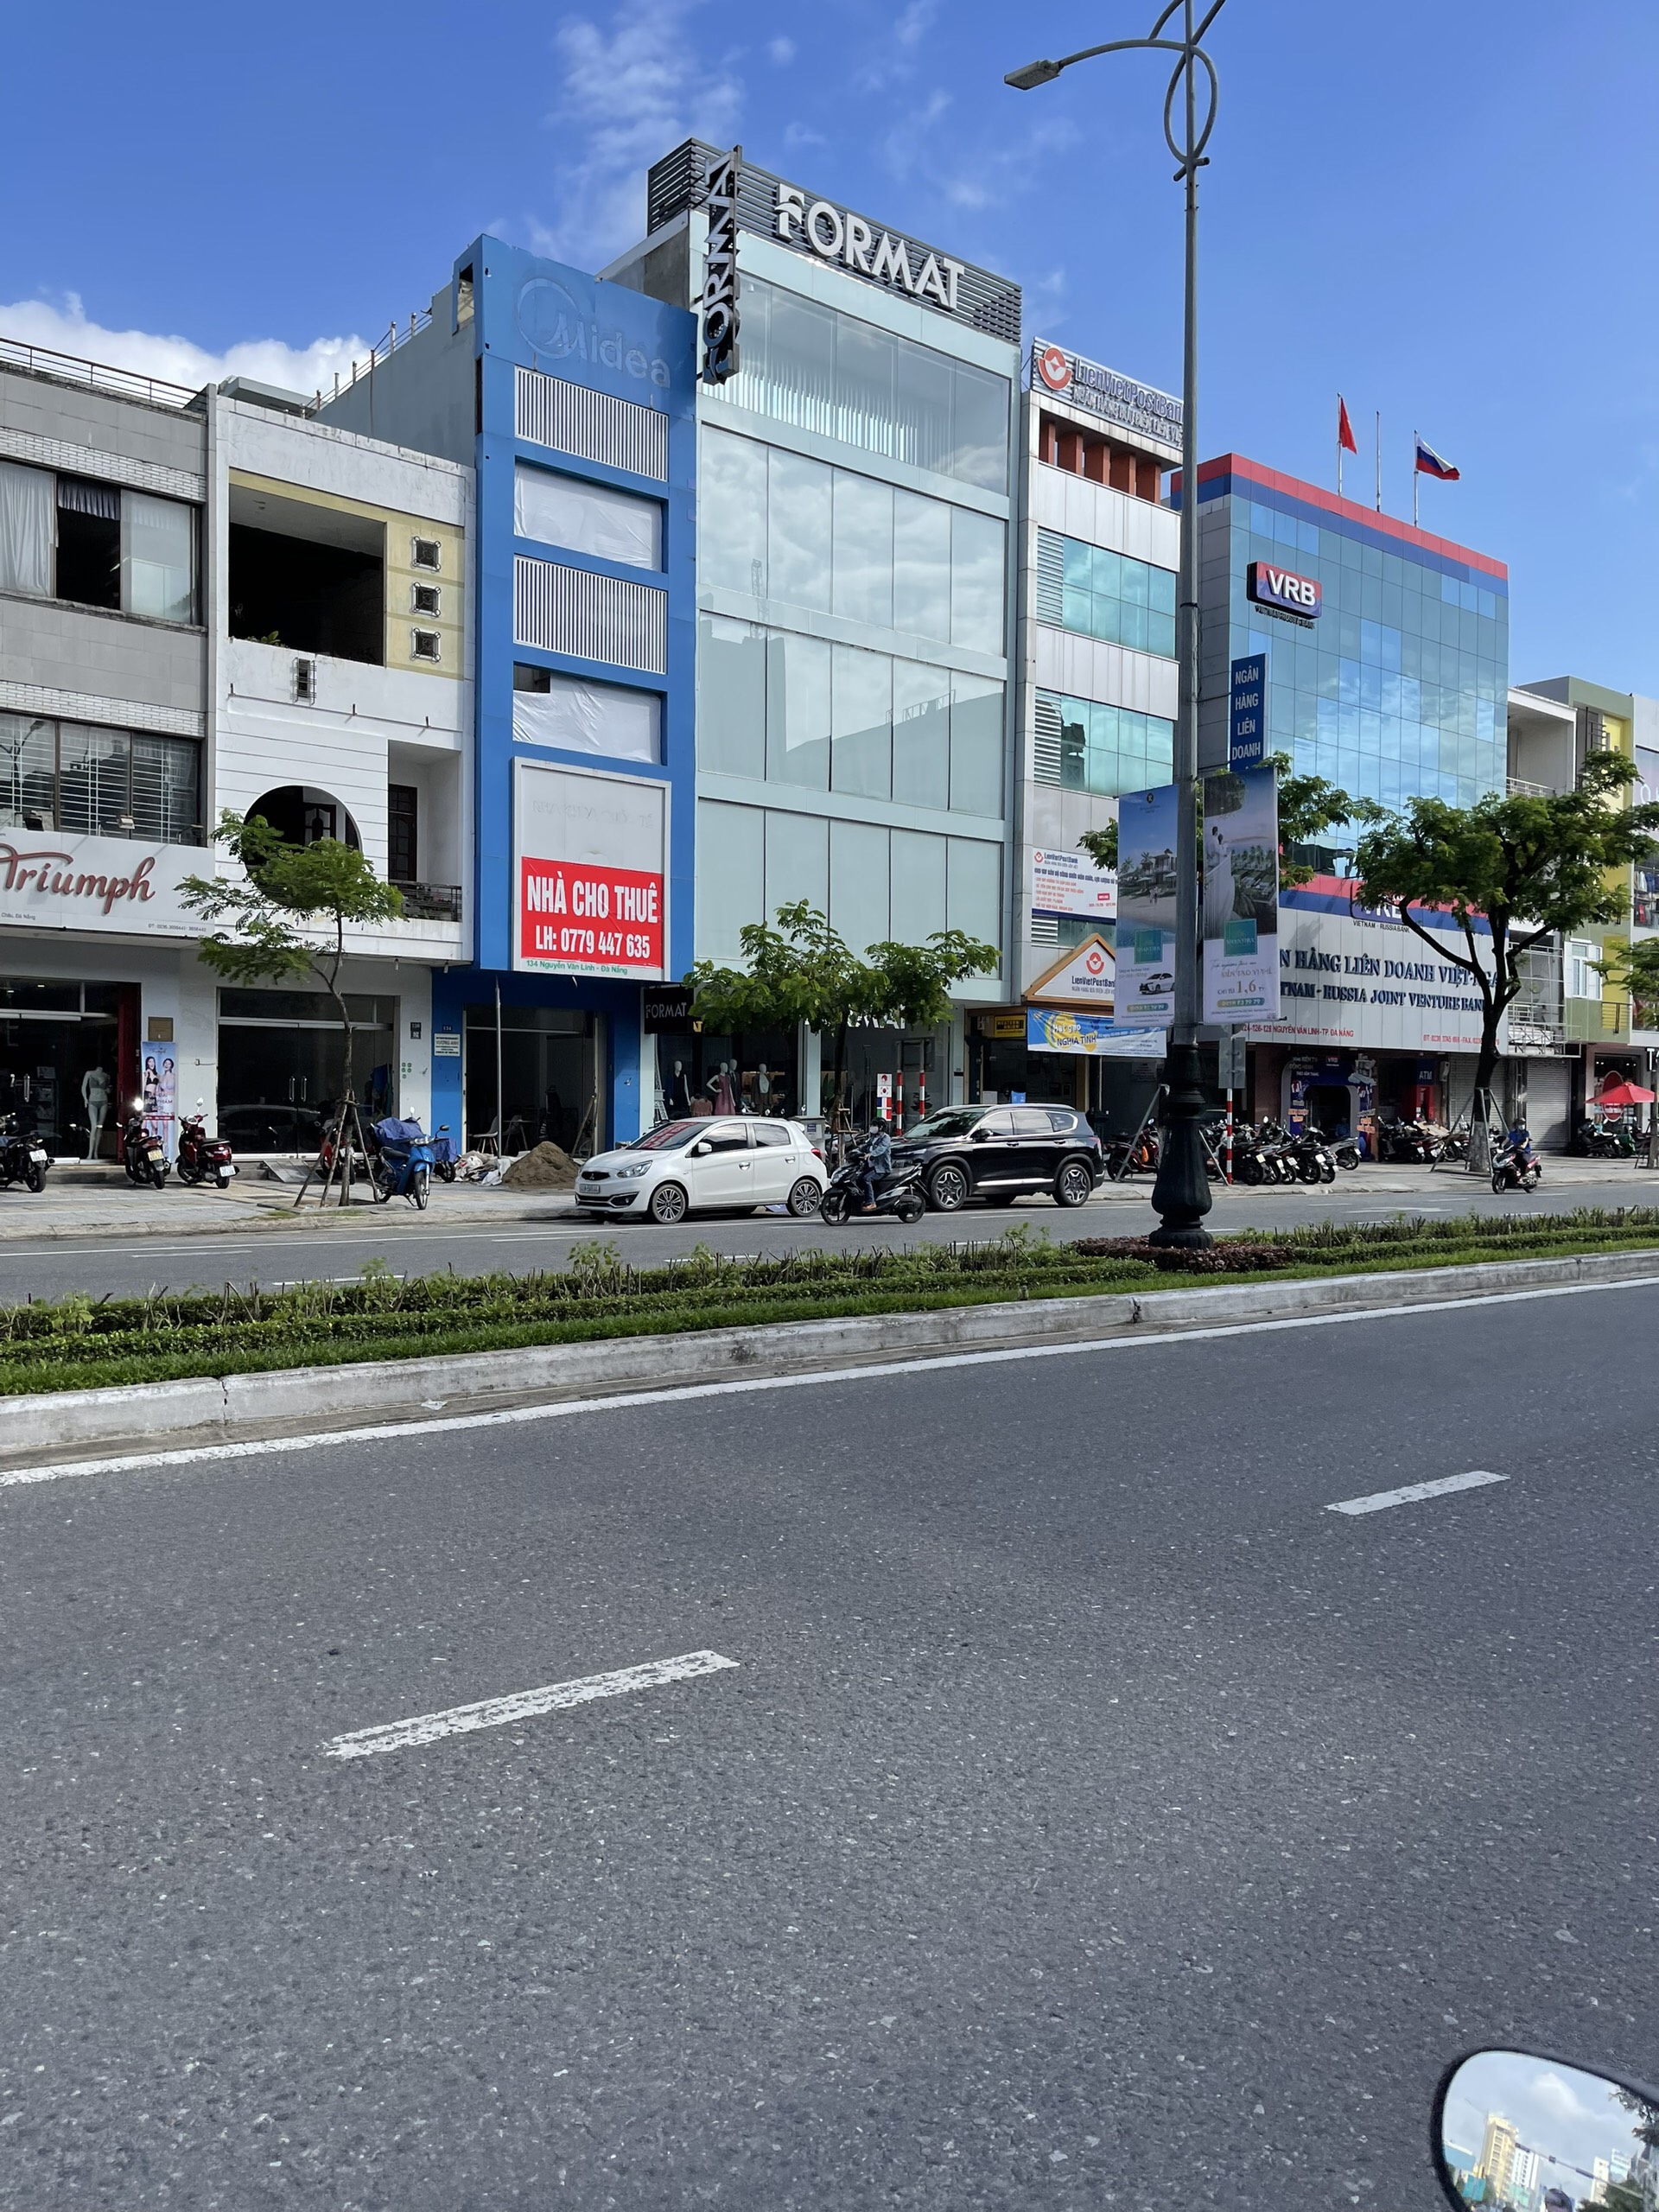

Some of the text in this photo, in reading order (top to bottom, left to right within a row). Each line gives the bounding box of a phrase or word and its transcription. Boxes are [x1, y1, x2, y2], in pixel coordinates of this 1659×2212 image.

[774, 183, 965, 310] FORMAT
[702, 149, 741, 385] FORMAT
[527, 292, 671, 389] Midea
[1075, 357, 1184, 423] LienVietPostBan
[1267, 569, 1316, 607] VRB
[1236, 665, 1259, 685] NGÂN
[1236, 692, 1259, 711] HÀNG
[1237, 717, 1255, 736] LIÊN
[1231, 741, 1261, 760] DOANH
[0, 842, 156, 914] Triumph
[527, 871, 658, 924] NHÀ CHO THUÊ
[1353, 920, 1376, 929] VIETNAM
[1397, 925, 1410, 933] BANK
[536, 925, 650, 958] LH: 0779 447 635
[540, 960, 566, 970] Nguyễn
[568, 962, 581, 970] Văn
[601, 963, 610, 972] Đà
[611, 965, 628, 975] Nẵng
[1295, 947, 1342, 973] HÀNG
[1345, 953, 1381, 976] LIÊN
[1384, 960, 1435, 982] DOANH
[1071, 976, 1116, 988] LienVietPostBan
[1236, 979, 1256, 994] 1,6
[1280, 981, 1316, 999] TNAM
[1323, 985, 1367, 1002] RUSSIA
[1370, 989, 1408, 1006] JOINT
[1408, 992, 1461, 1010] VENTURE
[1461, 997, 1485, 1012] BAN
[645, 1002, 687, 1019] FORMAT
[1273, 1024, 1296, 1034] NGUYỄN
[1419, 1071, 1433, 1080] ATM
